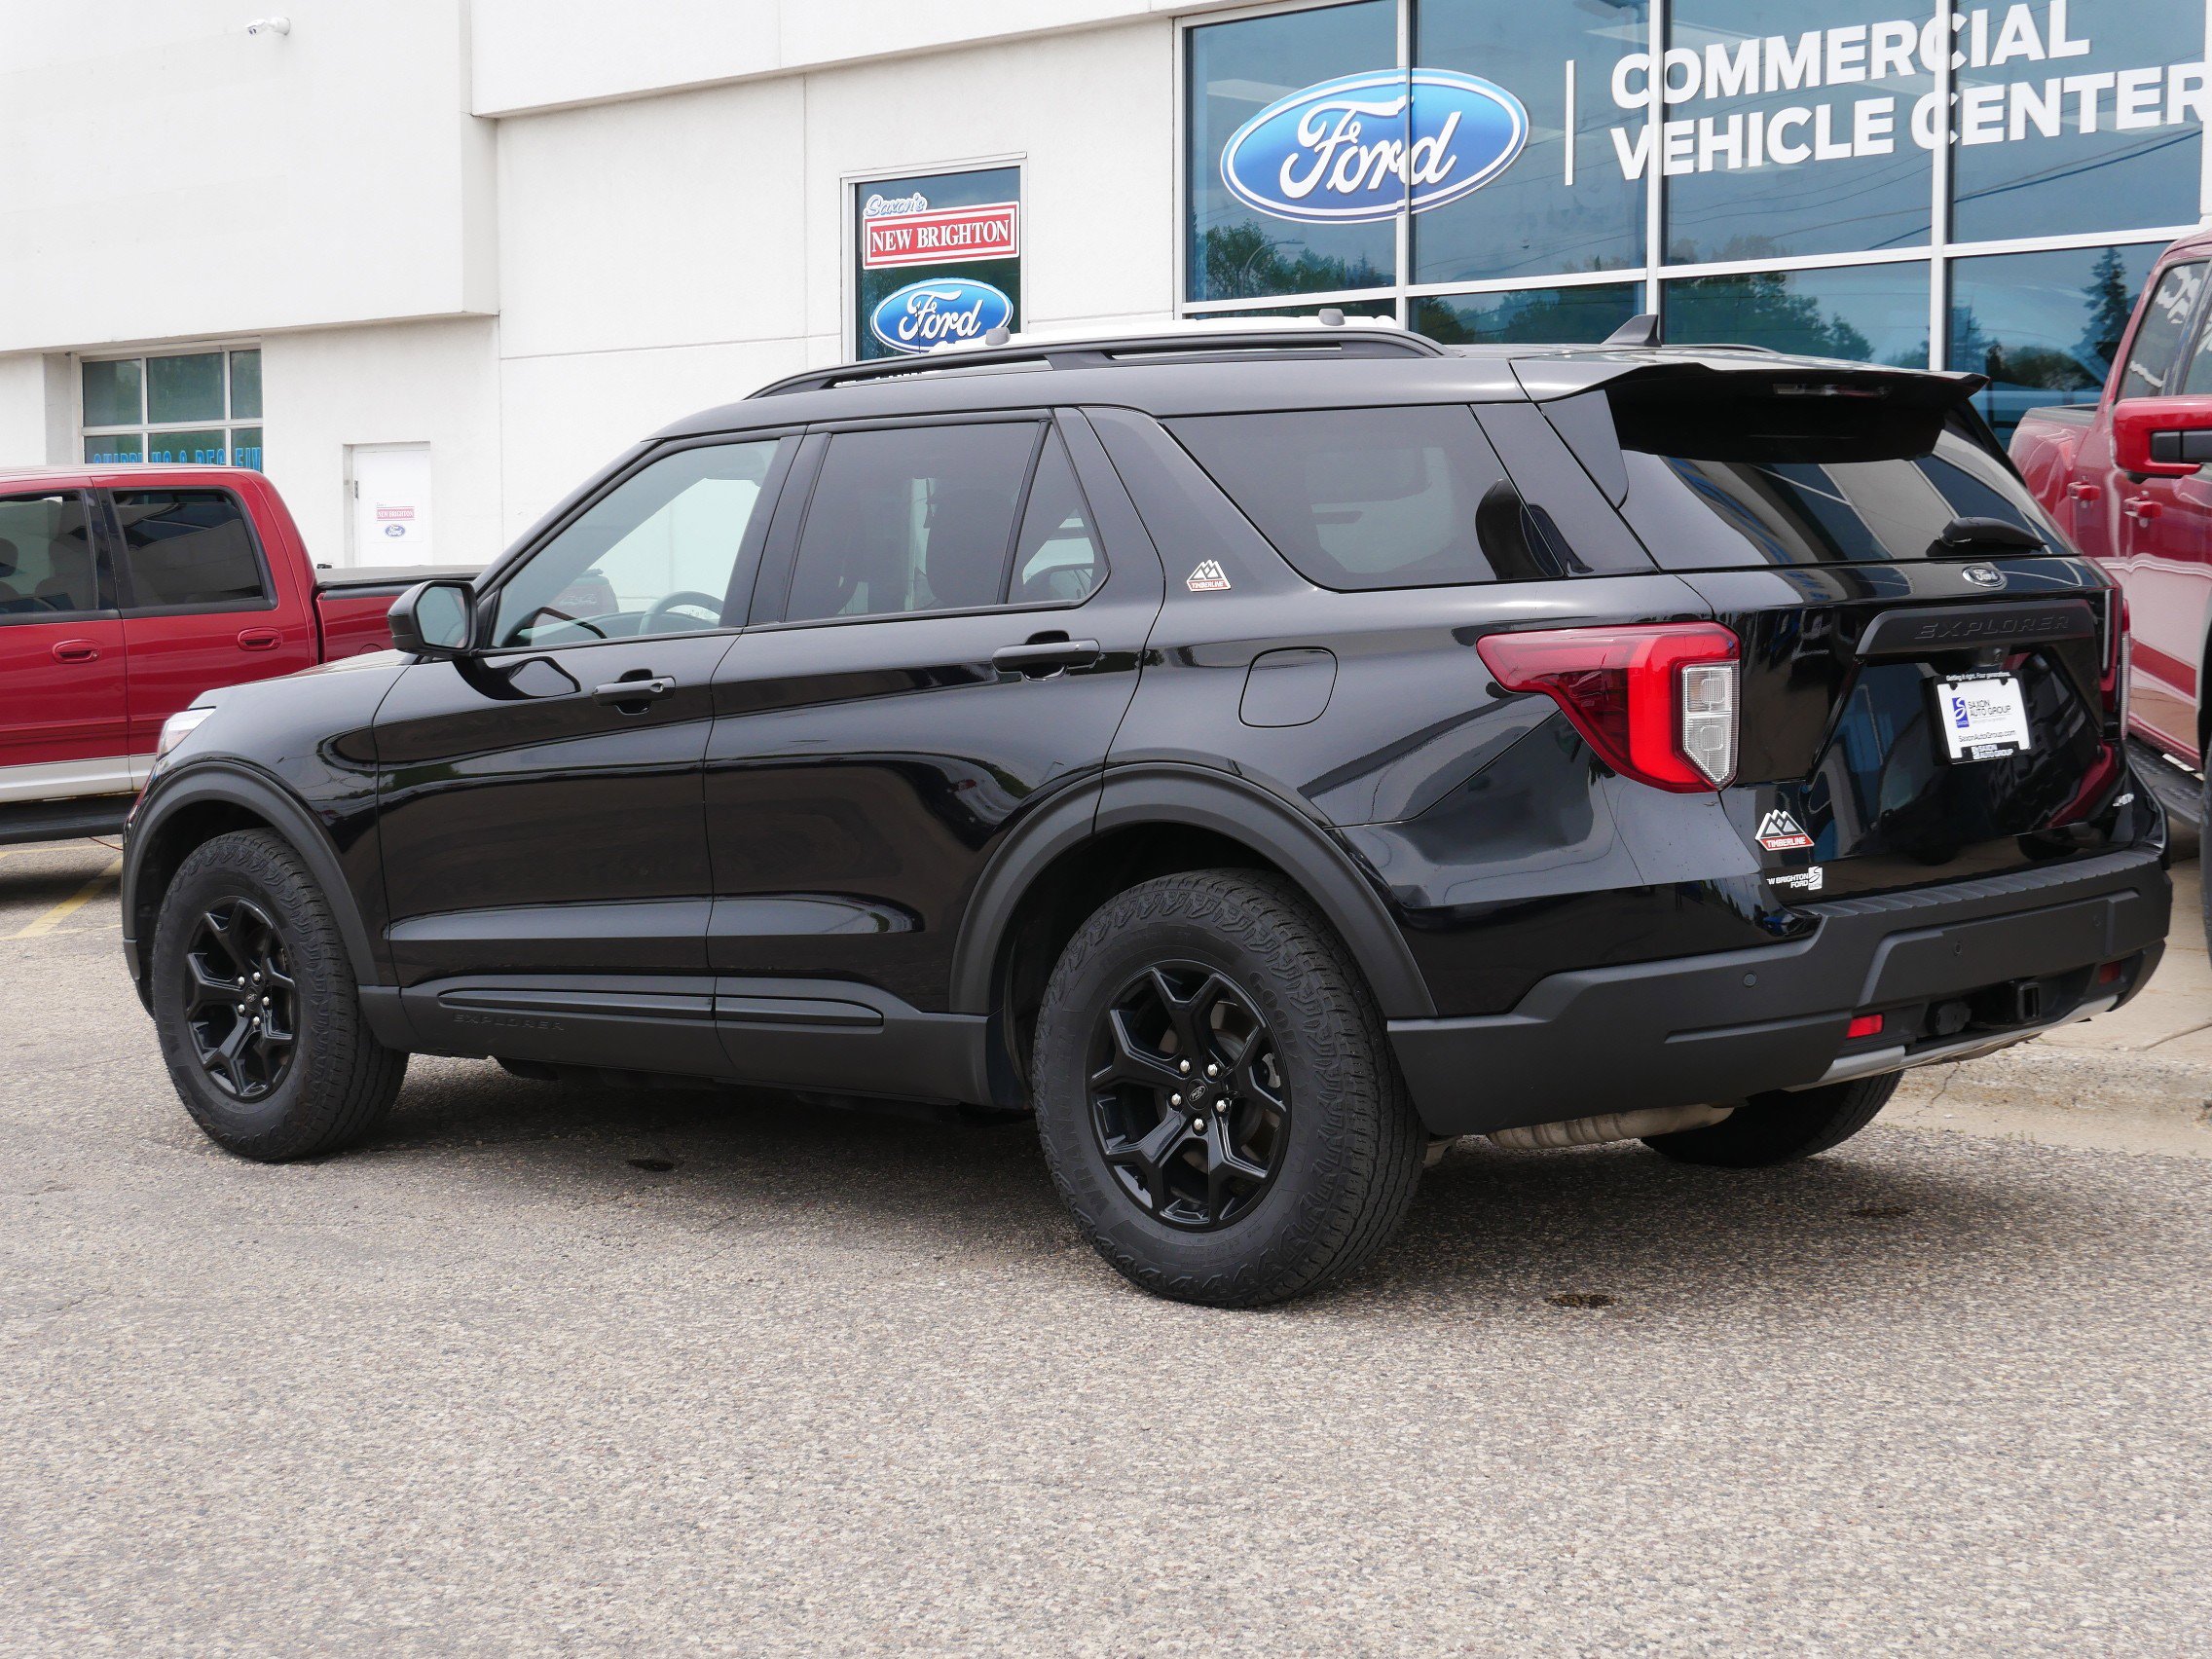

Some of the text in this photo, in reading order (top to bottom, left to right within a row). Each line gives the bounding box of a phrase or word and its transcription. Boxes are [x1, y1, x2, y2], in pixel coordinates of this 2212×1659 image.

[1611, 0, 2090, 109] COMMERCIAL
[1609, 61, 2208, 181] VEHICLE CENTER
[1279, 94, 1462, 199] Ford
[865, 194, 927, 218] Saxon's
[871, 219, 1011, 253] NEW BRIGHTON
[898, 288, 984, 341] Ford
[1191, 580, 1225, 589] TIMBERLINE
[1914, 615, 2070, 640] EXPLORER
[1968, 700, 1990, 710] SAXON
[1971, 705, 2011, 718] AUTO GROUP
[1959, 730, 2016, 742] SaxonAutoGroup.com
[1767, 837, 1806, 848] TIMBERLINE
[1777, 873, 1808, 883] BRIGHTON
